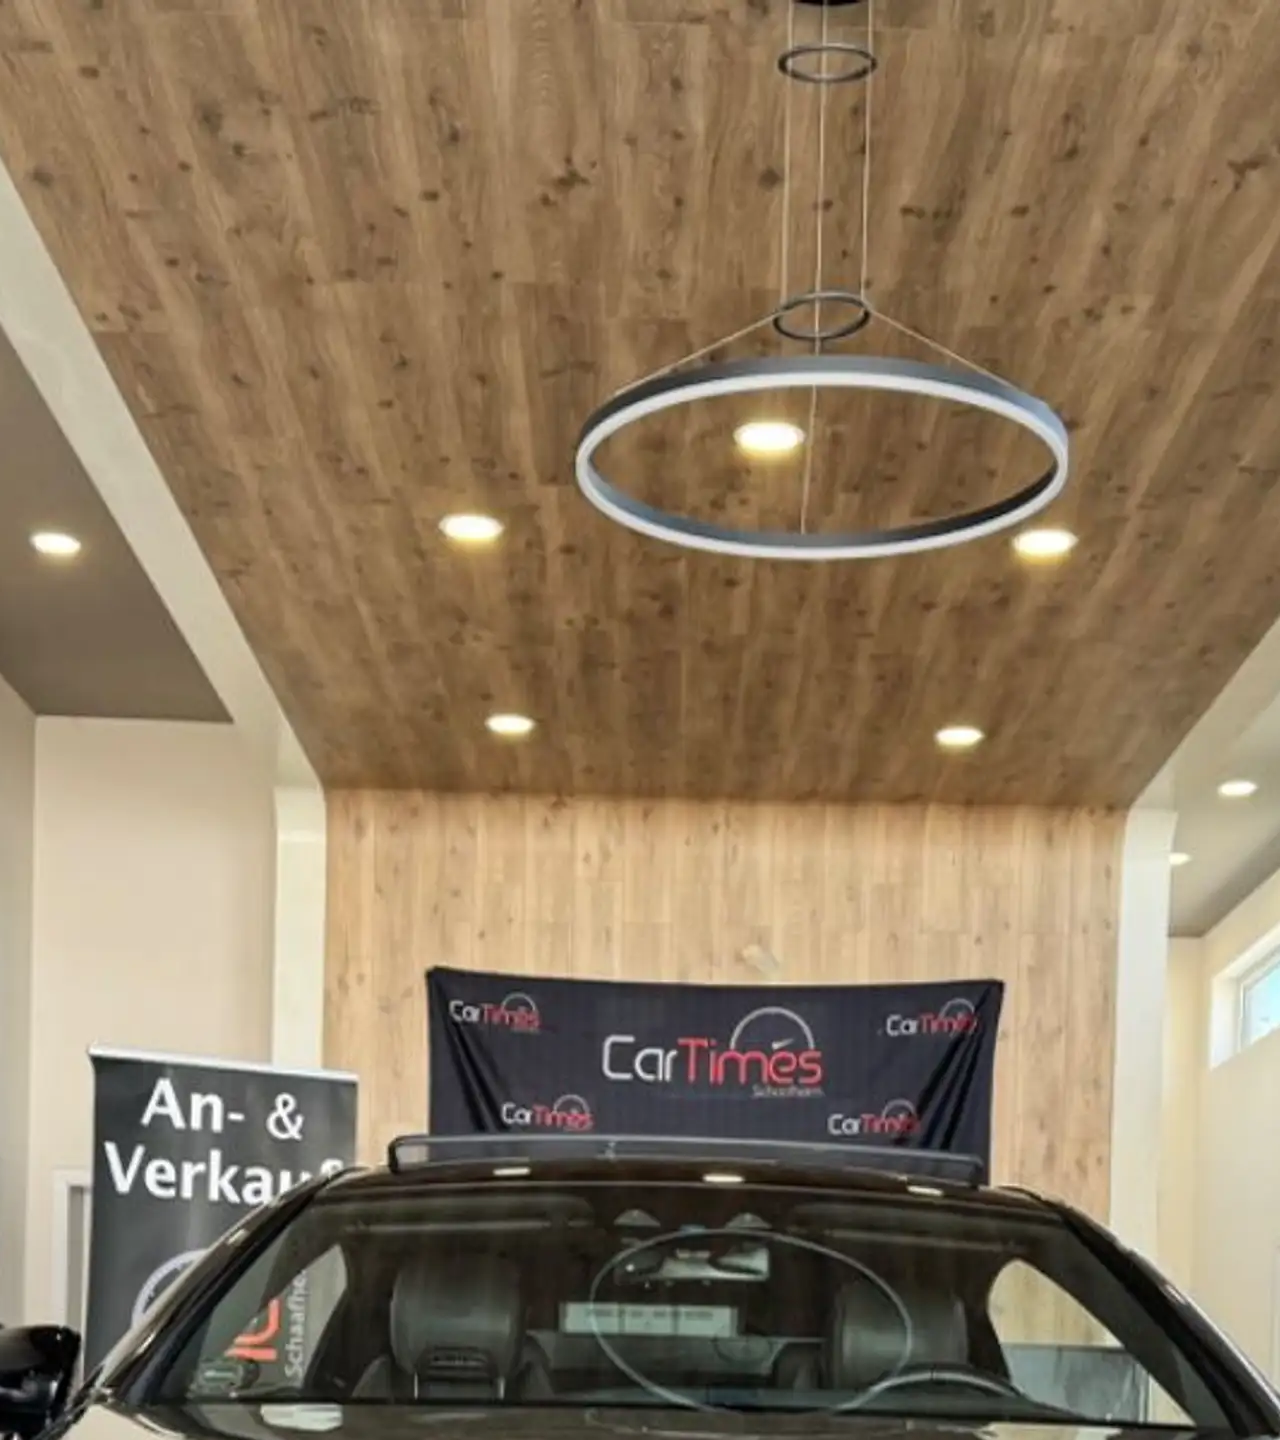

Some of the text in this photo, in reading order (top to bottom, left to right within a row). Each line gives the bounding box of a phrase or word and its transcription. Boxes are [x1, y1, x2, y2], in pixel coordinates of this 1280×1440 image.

[448, 999, 541, 1030] CarTimes
[602, 1035, 823, 1084] CarTimes
[140, 1077, 305, 1142] An- &
[500, 1100, 593, 1131] CarTimes
